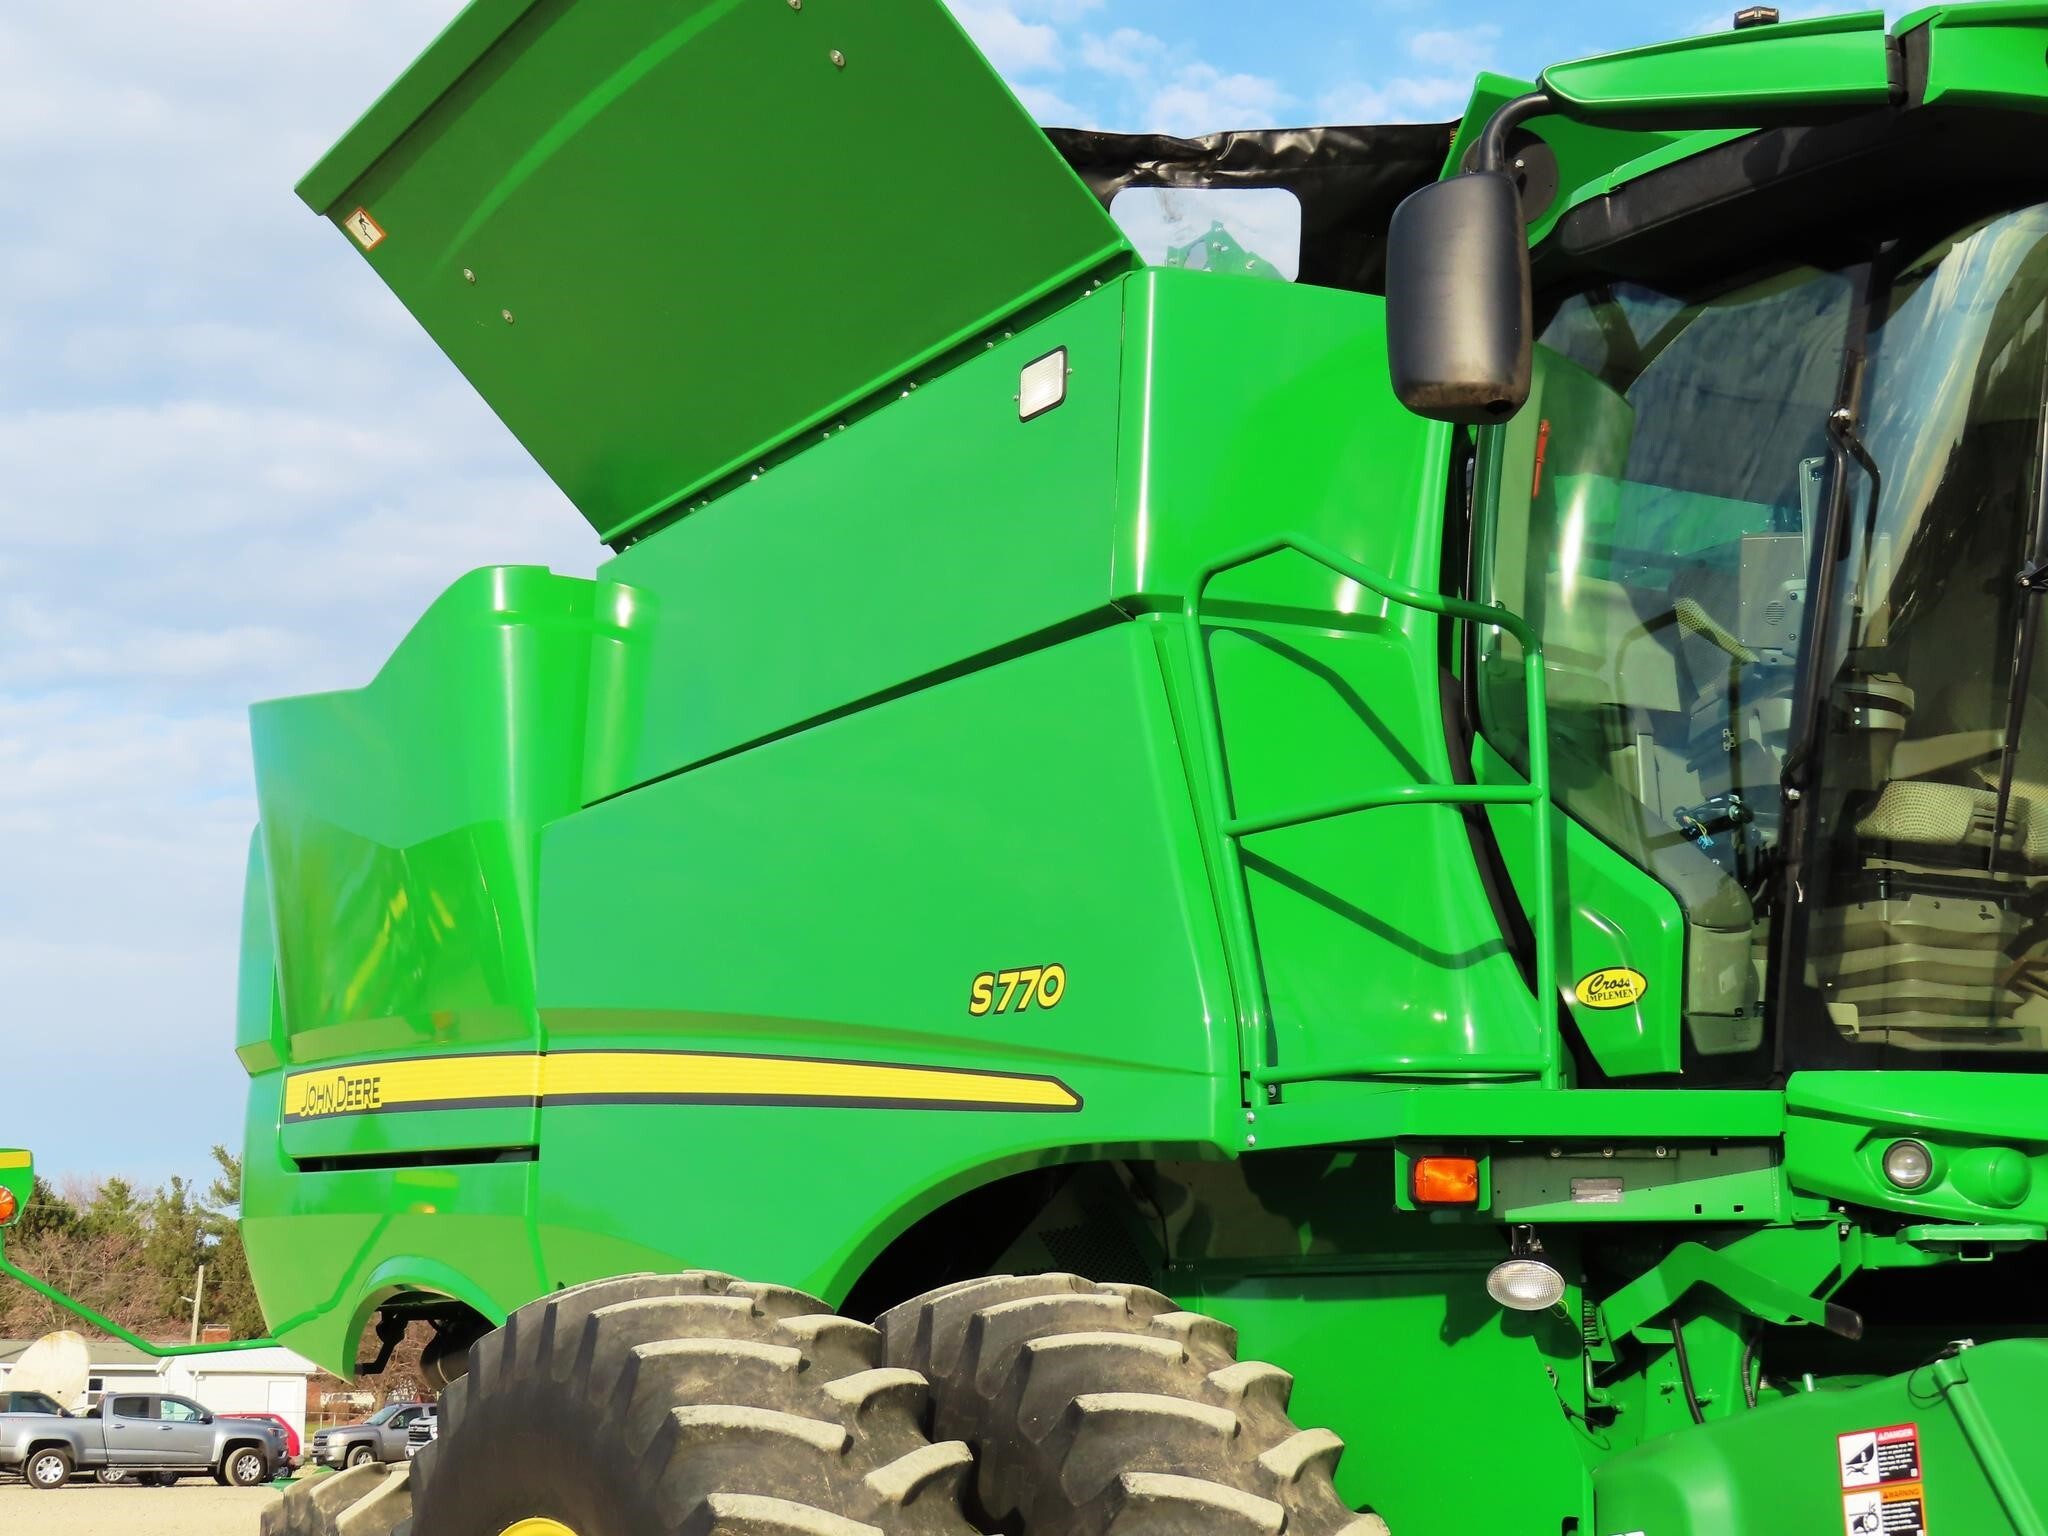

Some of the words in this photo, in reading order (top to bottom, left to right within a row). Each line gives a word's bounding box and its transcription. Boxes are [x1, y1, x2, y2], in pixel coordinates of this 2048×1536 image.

[968, 963, 1066, 1016] S770
[1588, 974, 1631, 995] Cross
[300, 1081, 335, 1113] JOHN
[337, 1075, 382, 1108] DEERE
